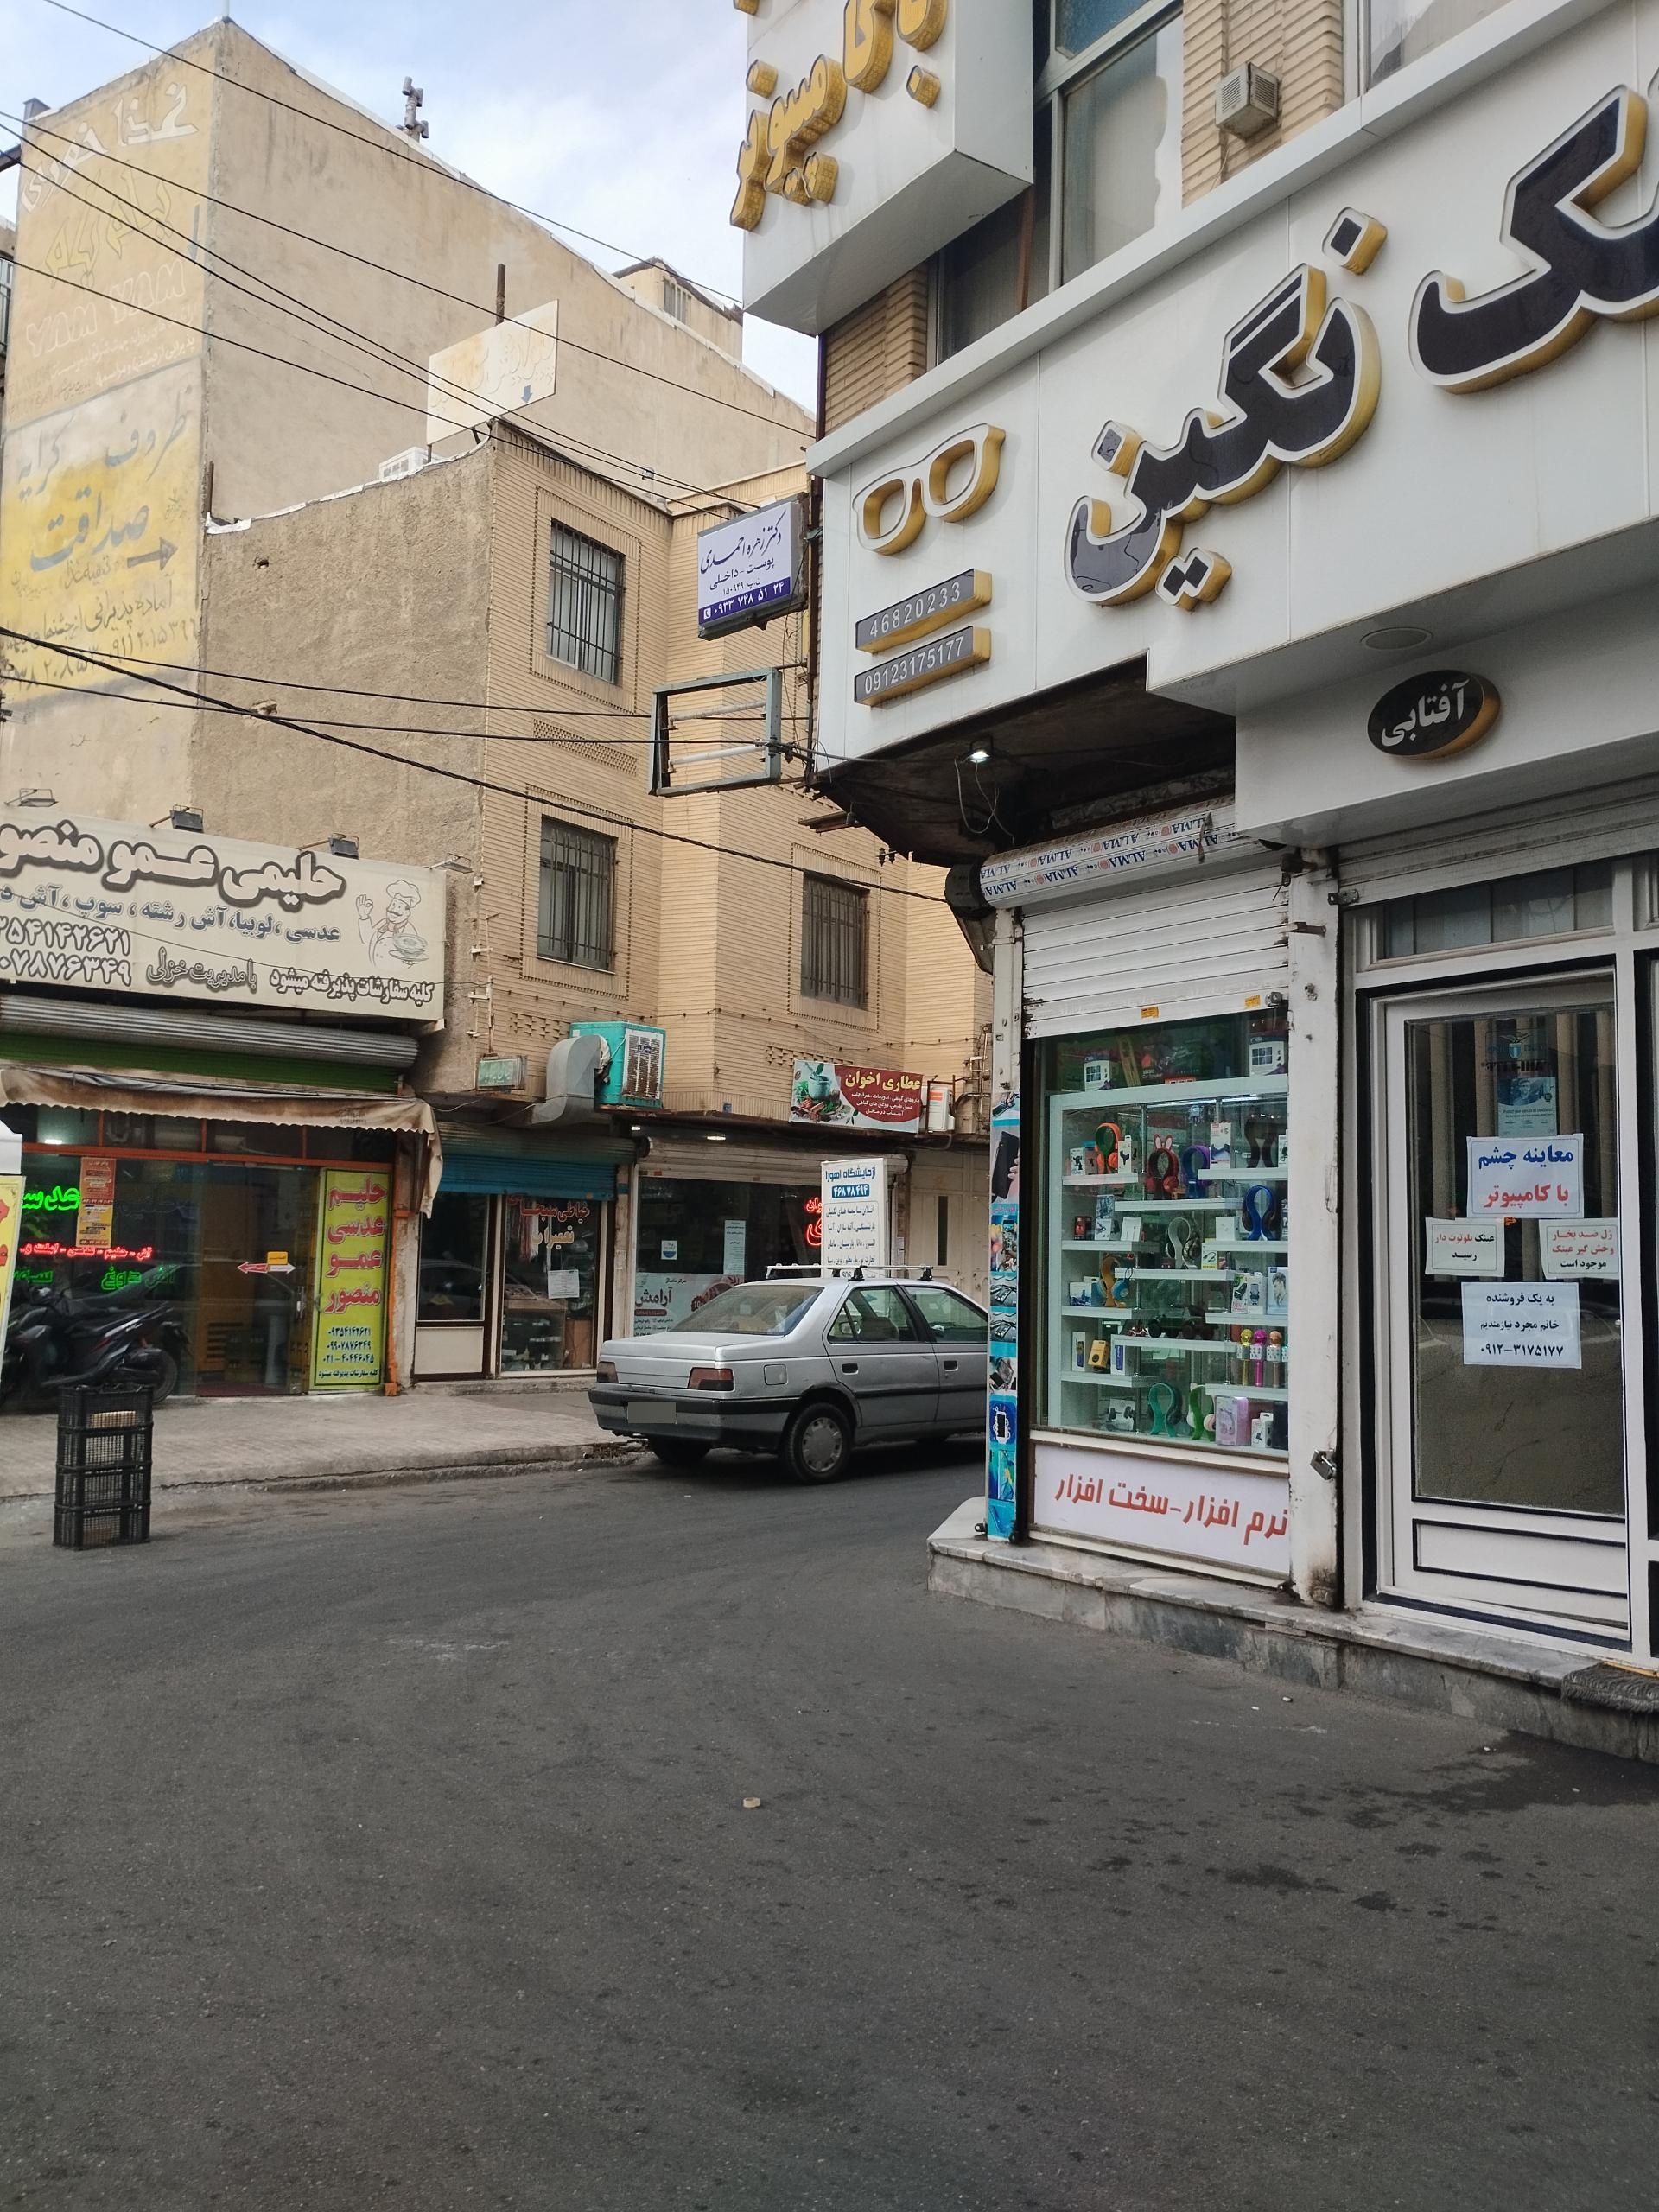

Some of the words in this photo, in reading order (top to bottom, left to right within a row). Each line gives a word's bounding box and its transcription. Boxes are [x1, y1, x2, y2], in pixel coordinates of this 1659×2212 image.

[116, 81, 199, 146] غذا
[1064, 207, 1387, 613] نگین
[105, 385, 190, 482] ظروف
[19, 413, 76, 501] کرایه
[29, 486, 149, 573] صداقت
[761, 510, 786, 556] دکتر
[747, 527, 766, 558] زهره
[700, 537, 745, 574] احمدی
[746, 557, 774, 574] پوست
[709, 569, 738, 590] داخلی
[715, 597, 734, 613] ۰۹۳۳
[758, 588, 767, 601] ۵۱
[870, 581, 961, 638] 46820233
[864, 635, 964, 696] 09123175177
[1382, 679, 1469, 747] آفتابی
[0, 818, 104, 879] منصو
[1102, 832, 1140, 851] ALMA
[101, 840, 219, 893] عمو
[1038, 848, 1073, 867] ALMA
[1109, 850, 1146, 868] ALMA
[219, 852, 346, 912] حلیمی
[1045, 866, 1078, 882] ALMA
[20, 884, 62, 909] آش
[986, 880, 1017, 896] ALMA
[75, 897, 123, 919] سوپ
[142, 901, 186, 928] رشته
[191, 906, 227, 930] آش
[286, 927, 340, 943] عدسی
[147, 946, 188, 987] خزلی
[189, 963, 246, 991] مدیریت
[246, 959, 257, 993] با
[270, 967, 309, 994] میشود
[310, 969, 357, 1001] پذیرفته
[357, 976, 408, 1003] سفارشات
[407, 982, 434, 1006] کلیه
[845, 1070, 880, 1089] اخوان
[882, 1075, 921, 1092] عطاری
[1478, 1147, 1516, 1169] چشم
[1523, 1145, 1573, 1167] معاینه
[826, 1169, 841, 1182] اهورا
[843, 1165, 876, 1179] آزمایشگاه
[22, 1185, 80, 1211] عدس
[328, 1174, 387, 1211] حلیم
[1484, 1184, 1551, 1208] کامپیوتر
[1556, 1184, 1568, 1206] با
[557, 1201, 589, 1223] خیاطی
[327, 1216, 385, 1244] عدسی
[1434, 1234, 1446, 1243] دار
[1475, 1234, 1495, 1244] عینک
[1553, 1230, 1576, 1241] بخار
[1601, 1228, 1613, 1240] ژل
[1452, 1251, 1478, 1262] رسید
[1553, 1244, 1573, 1255] عینک
[326, 1249, 382, 1278] عمو
[1560, 1259, 1578, 1268] است
[1580, 1261, 1606, 1269] موجود
[101, 1266, 143, 1291] دوغ
[324, 1281, 381, 1313] منصور
[635, 1286, 673, 1307] آرامش
[1486, 1292, 1524, 1306] فروشنده
[1527, 1293, 1542, 1306] یک
[1546, 1294, 1554, 1306] به
[1480, 1320, 1512, 1331] نیازمندیم
[1514, 1321, 1537, 1332] مجرد
[1540, 1319, 1559, 1332] خانم
[1055, 1473, 1103, 1503] افزار
[1243, 1508, 1288, 1546] نرم
